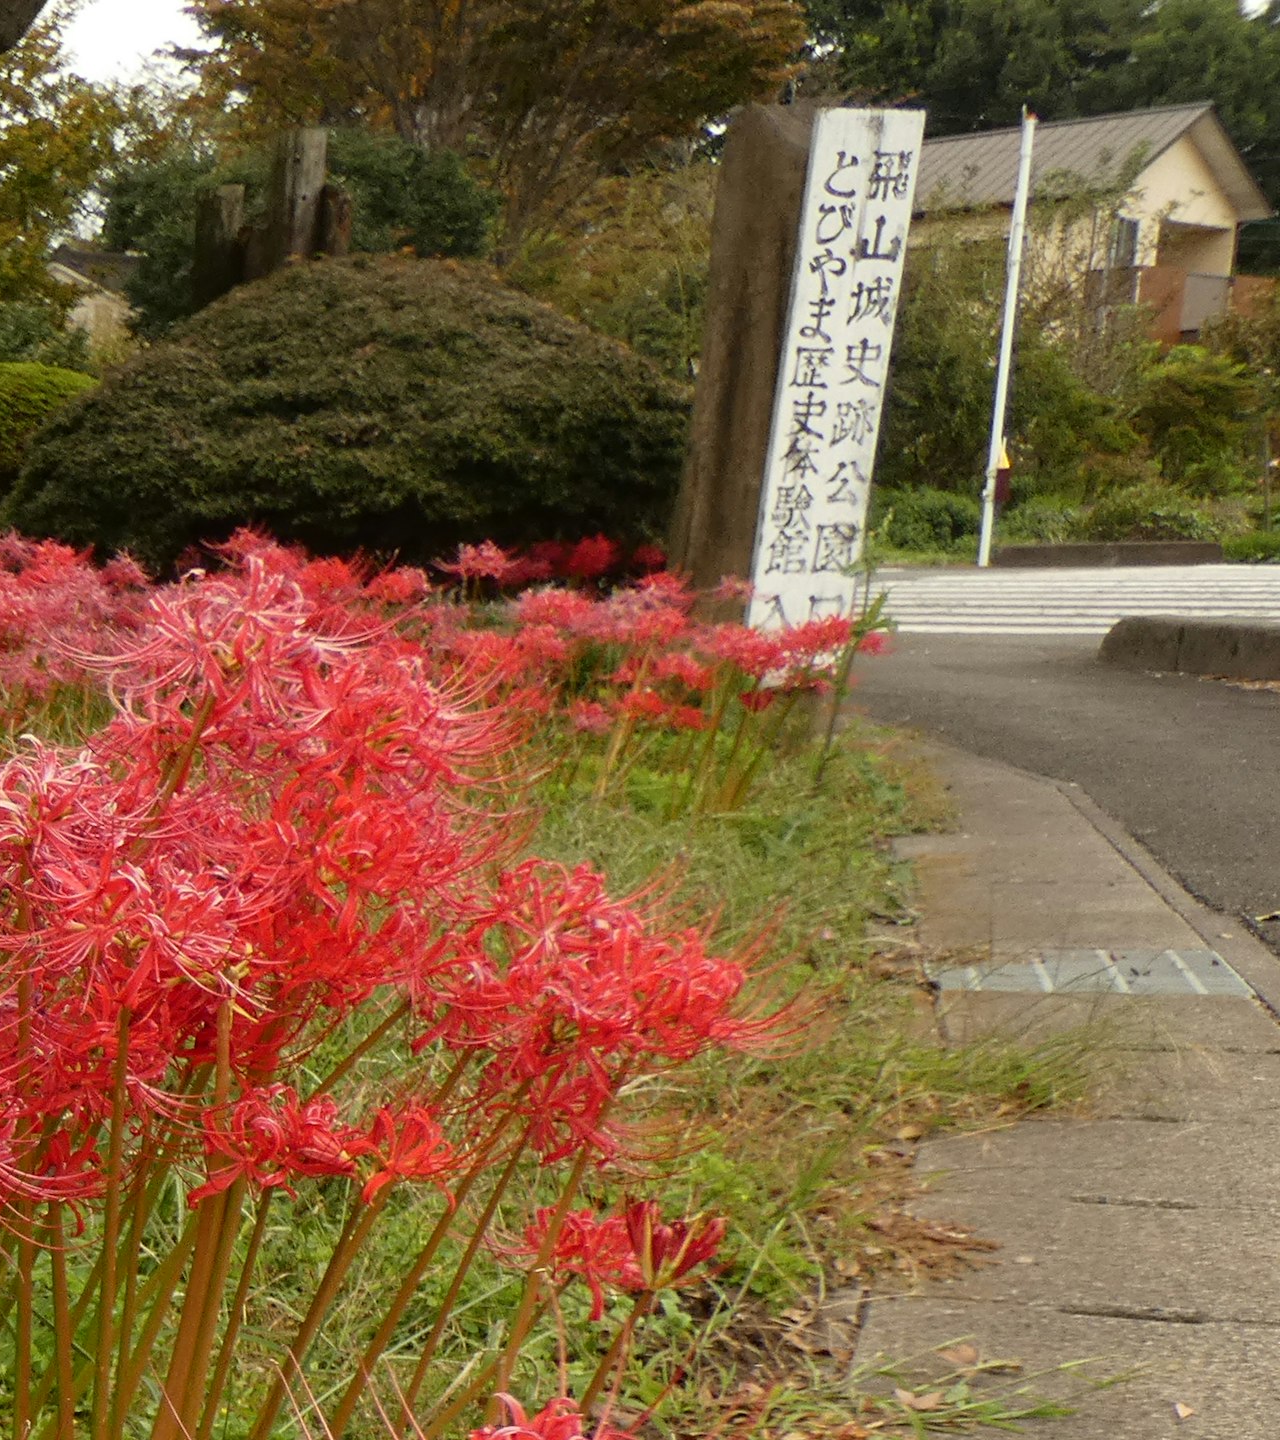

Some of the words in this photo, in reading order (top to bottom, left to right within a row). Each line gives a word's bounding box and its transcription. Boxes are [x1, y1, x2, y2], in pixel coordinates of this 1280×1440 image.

[810, 150, 912, 574] 飛山城史跡公園
